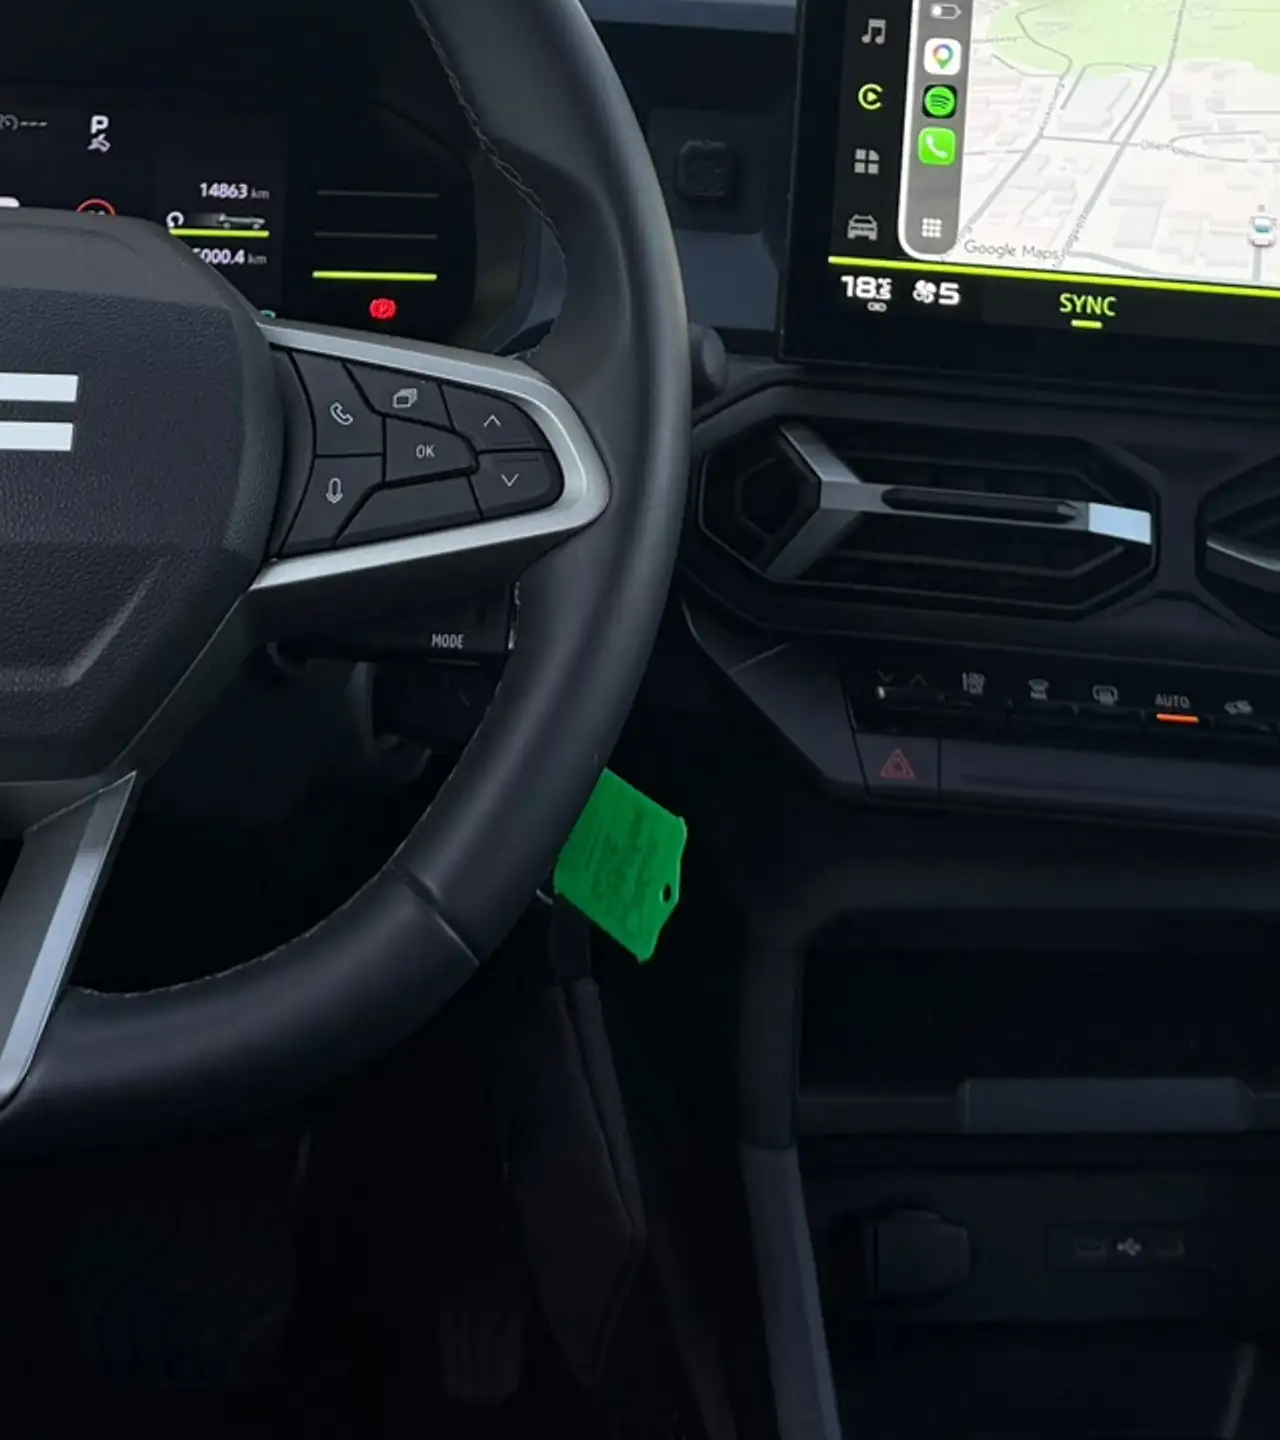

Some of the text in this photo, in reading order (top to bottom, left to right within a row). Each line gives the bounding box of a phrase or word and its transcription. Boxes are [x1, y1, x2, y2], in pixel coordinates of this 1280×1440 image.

[89, 113, 111, 135] P
[199, 182, 271, 200] 14863 km
[192, 247, 268, 265] 000.4 km
[964, 239, 1061, 262] Google Maps
[938, 281, 961, 306] 5
[1058, 292, 1118, 318] SYNC
[415, 444, 436, 459] OK
[430, 633, 465, 649] MODE
[1154, 691, 1192, 709] AUTO
